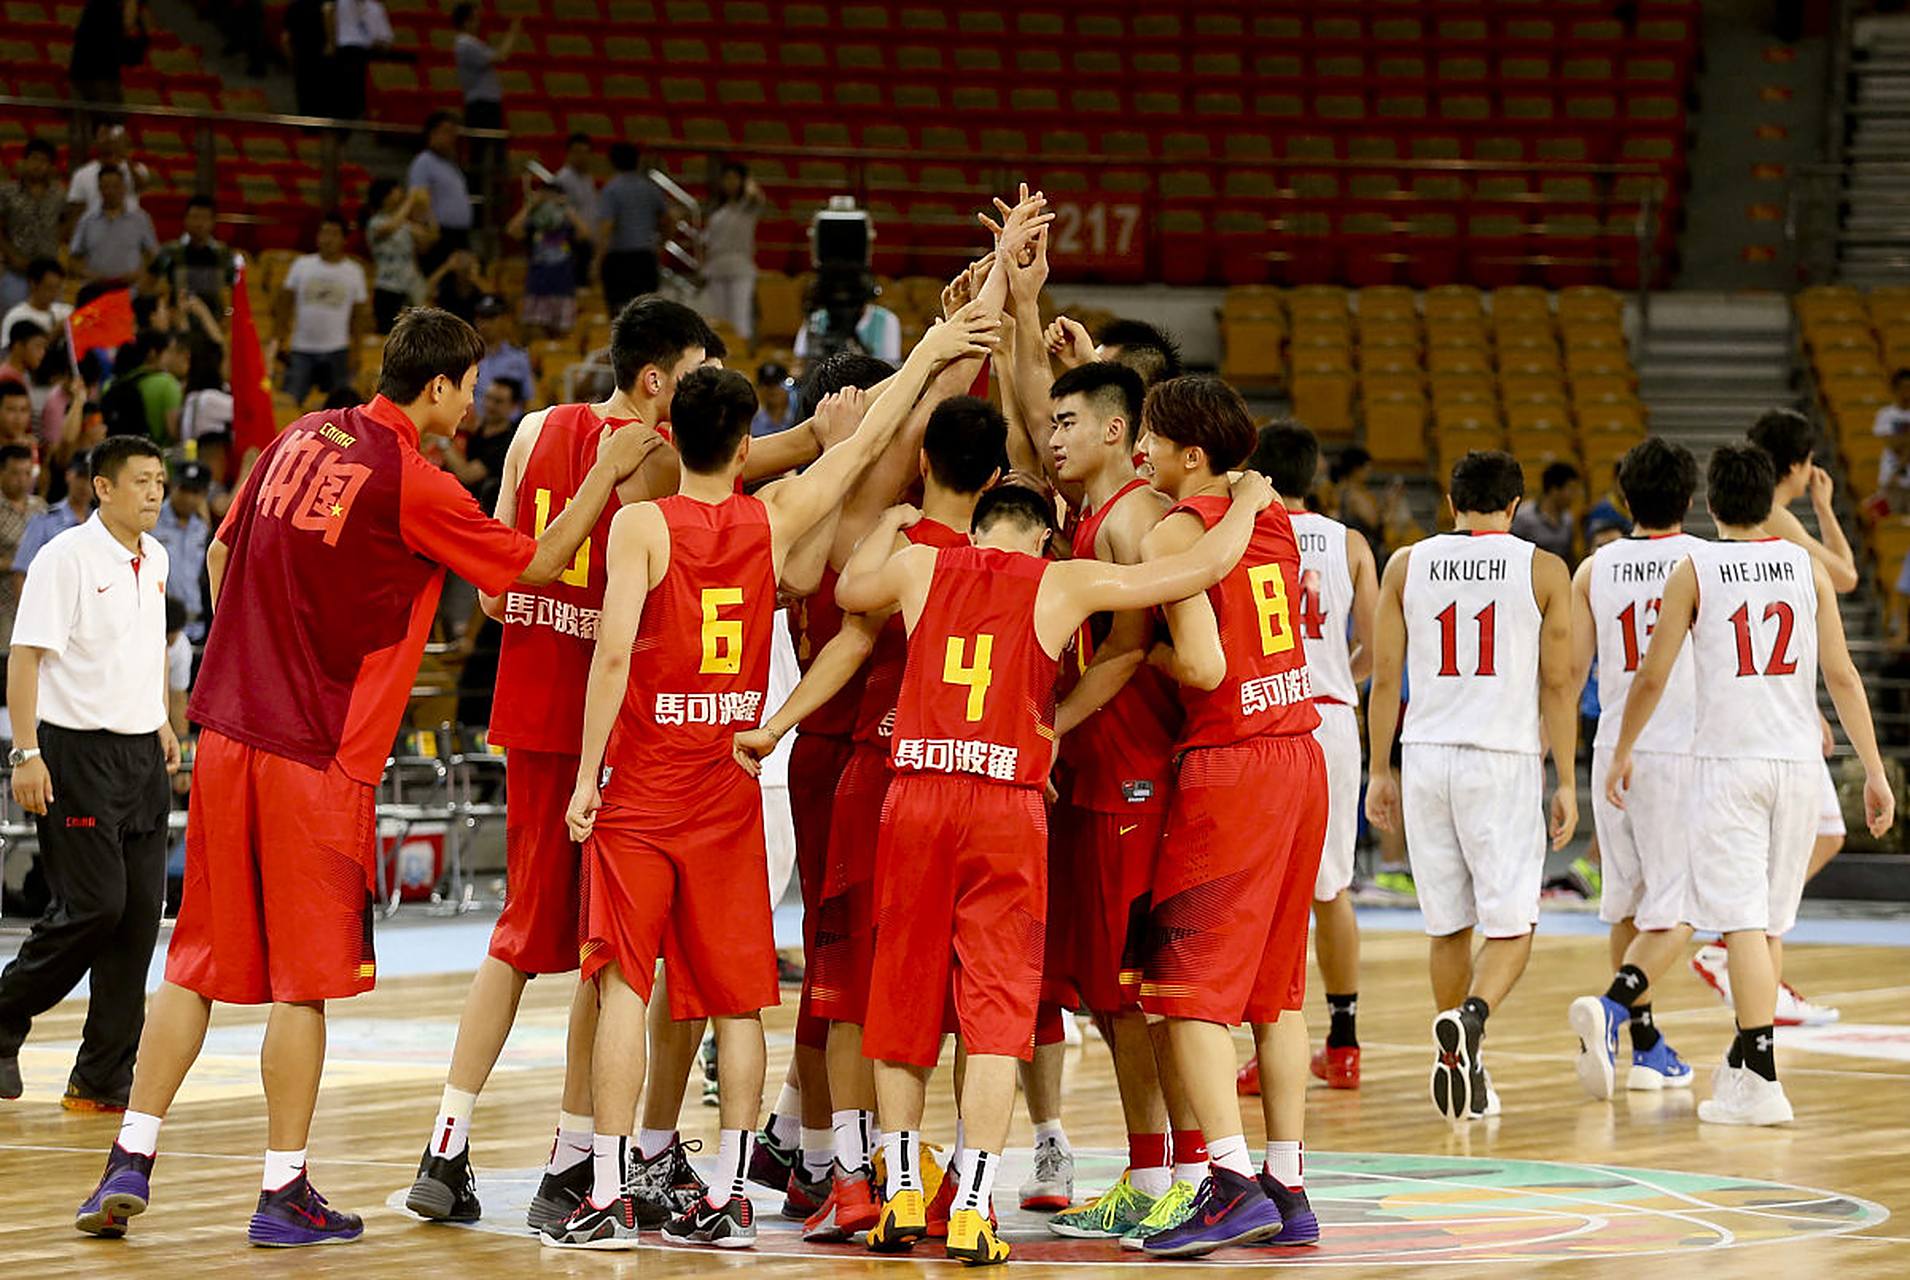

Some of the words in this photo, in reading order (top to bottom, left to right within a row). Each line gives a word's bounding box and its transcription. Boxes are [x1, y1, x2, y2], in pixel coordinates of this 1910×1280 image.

[319, 421, 357, 449] CHINA
[1429, 559, 1507, 581] KIKUCHI
[1719, 561, 1795, 583] HIEJIMA
[699, 587, 744, 674] 6
[1247, 562, 1295, 657] 8
[1434, 599, 1497, 677] 11
[1727, 599, 1798, 677] 12
[942, 633, 994, 722] 4
[894, 738, 1018, 781] 馬可波羅
